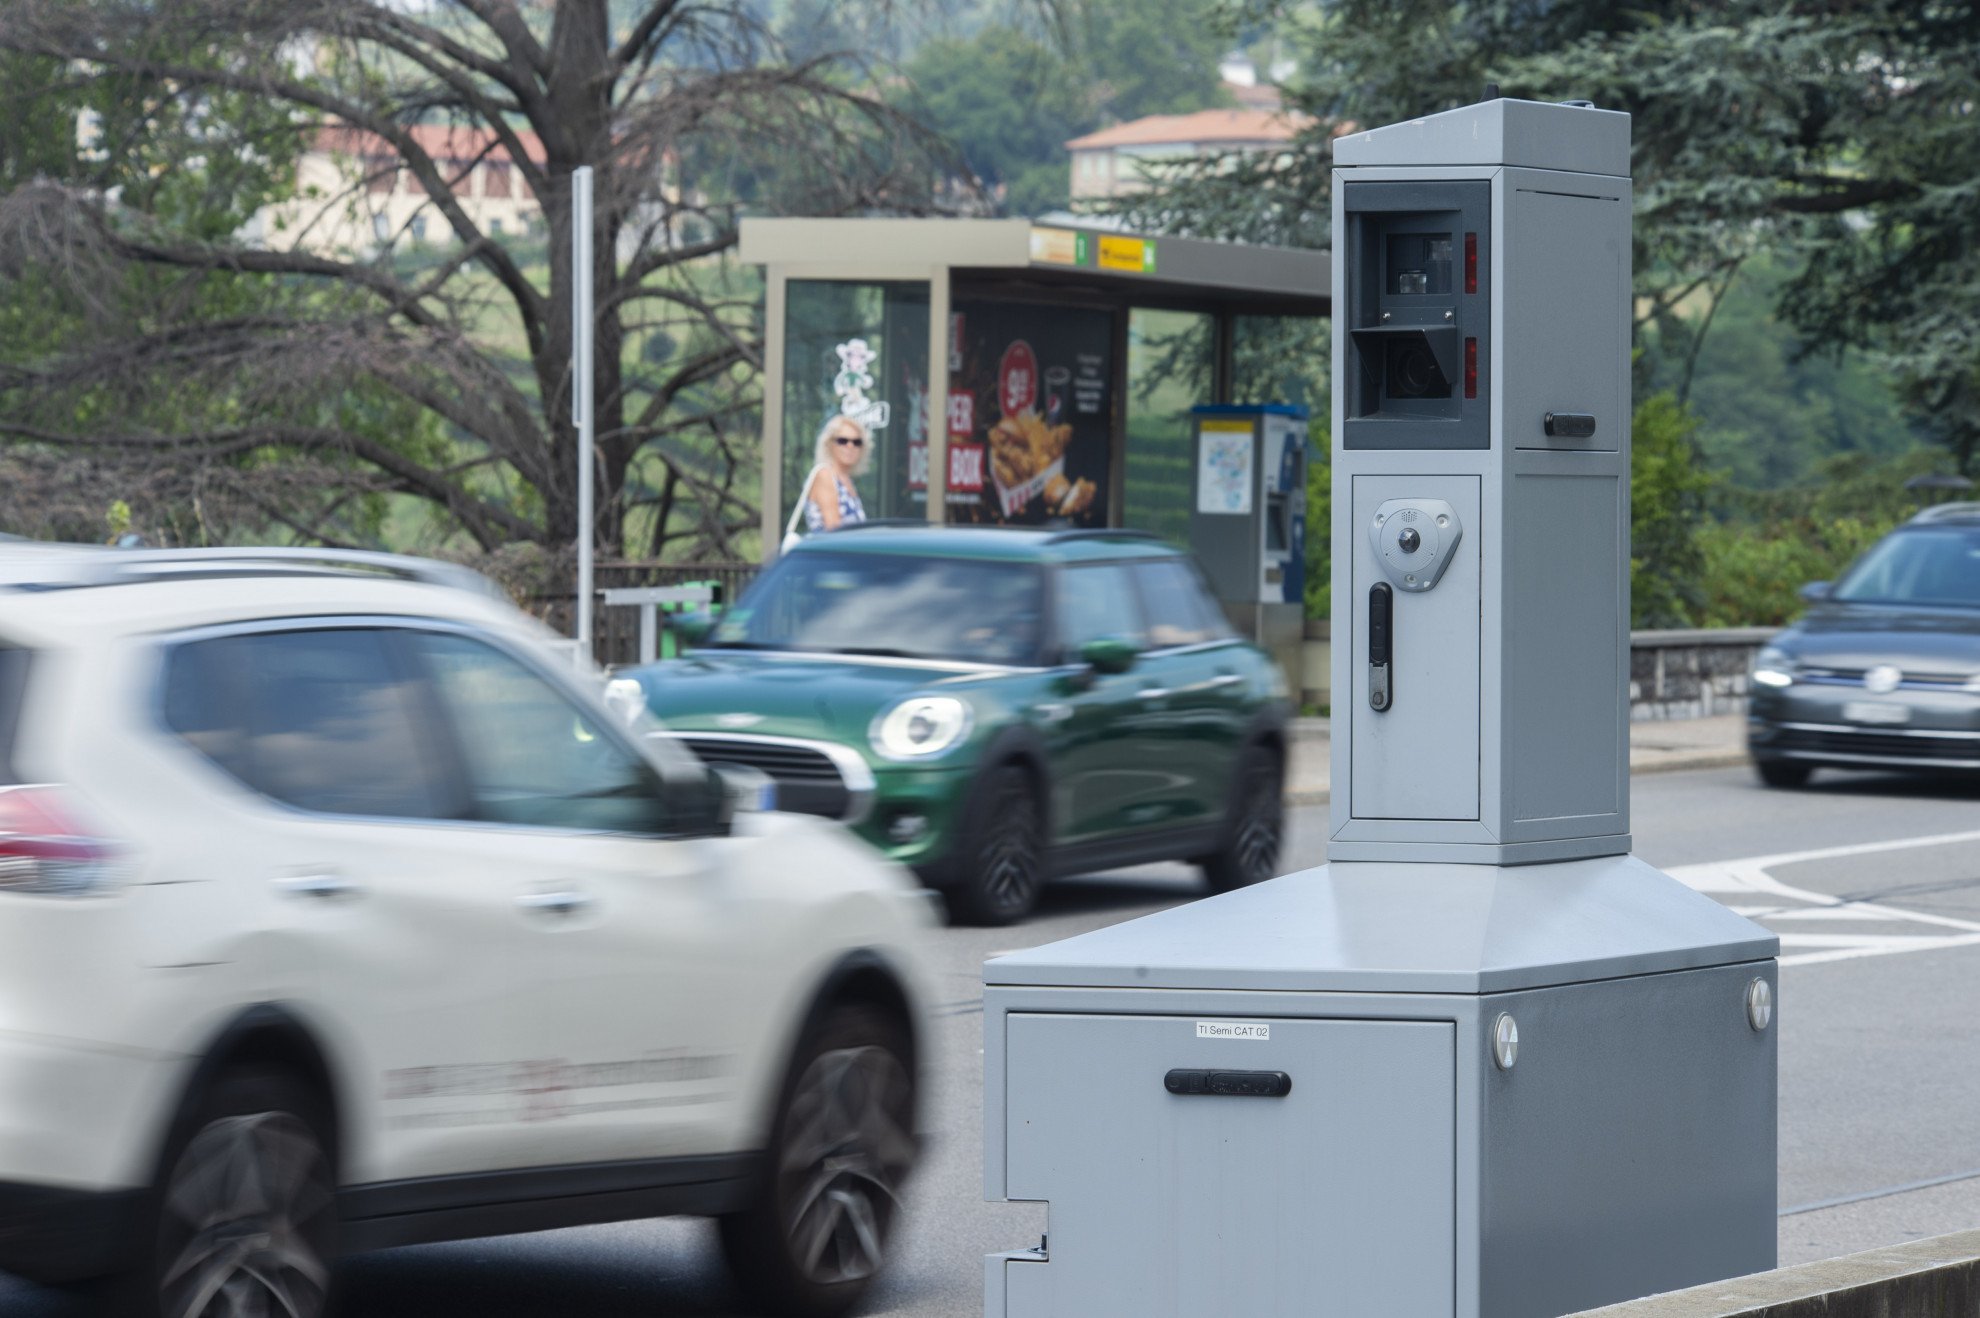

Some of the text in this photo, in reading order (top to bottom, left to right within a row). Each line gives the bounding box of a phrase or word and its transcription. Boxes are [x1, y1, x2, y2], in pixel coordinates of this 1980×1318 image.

[922, 393, 973, 431] SPER
[951, 448, 983, 486] BOX
[1199, 1025, 1268, 1037] TI Semi CAT 02
